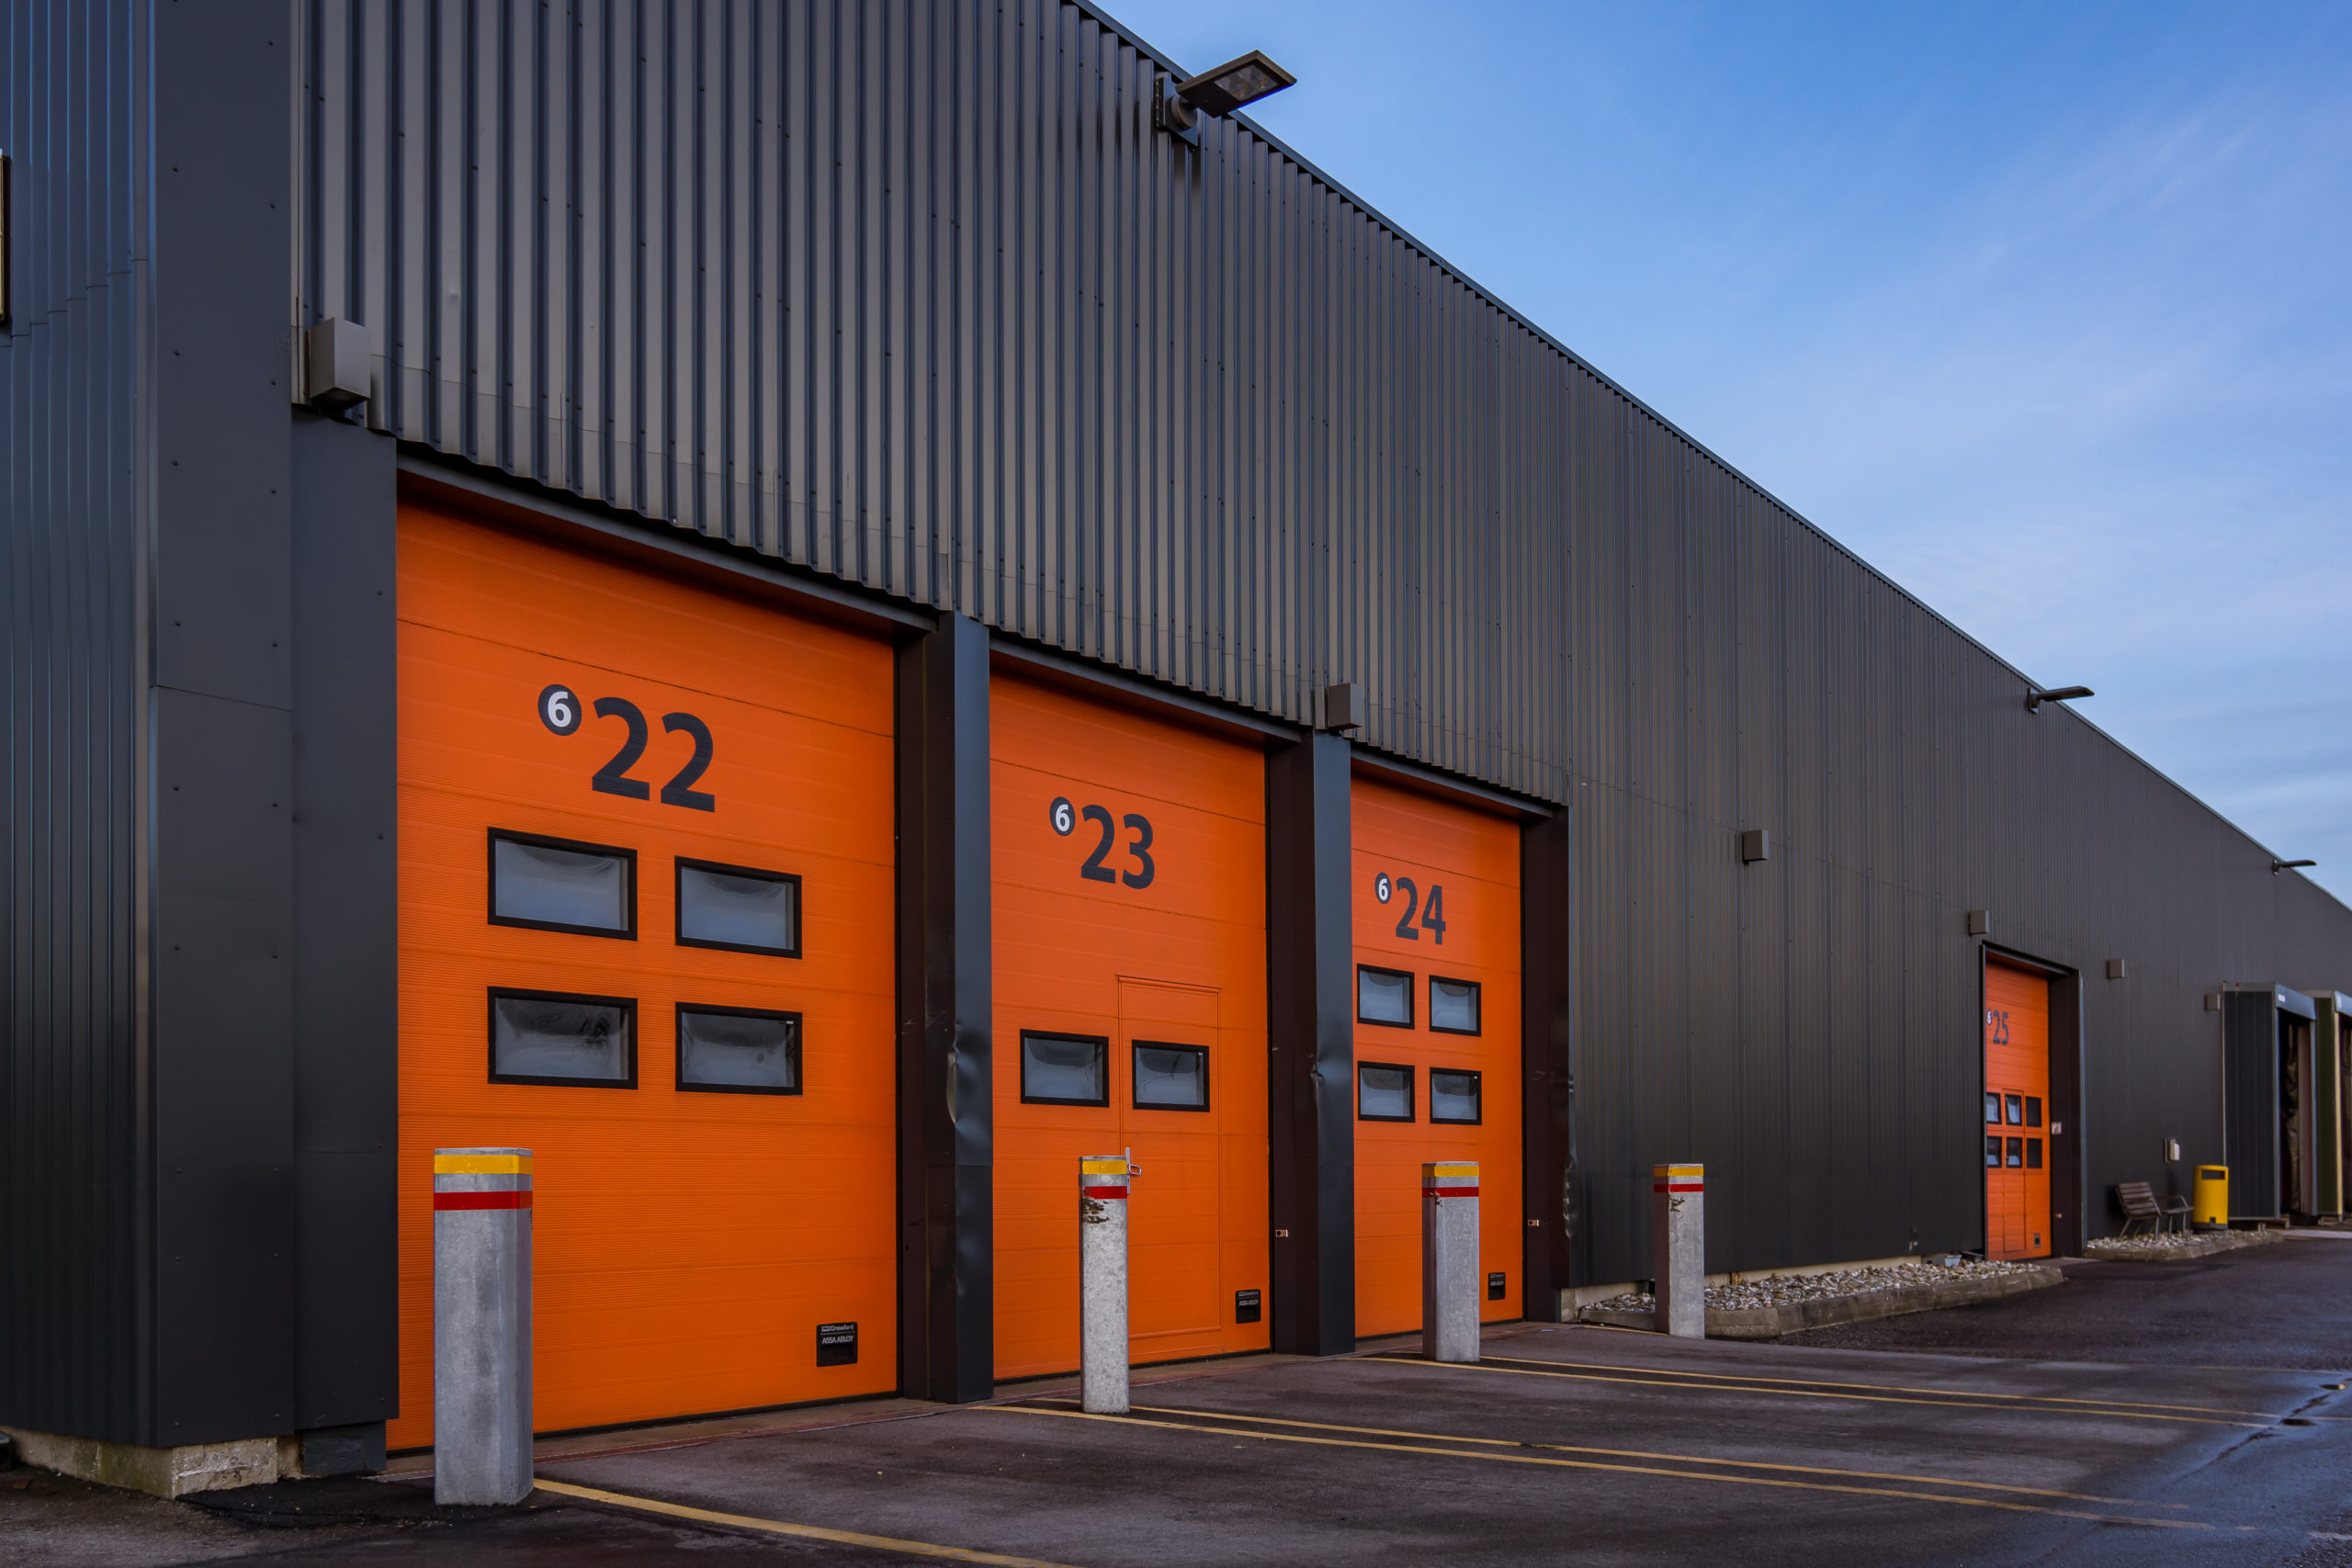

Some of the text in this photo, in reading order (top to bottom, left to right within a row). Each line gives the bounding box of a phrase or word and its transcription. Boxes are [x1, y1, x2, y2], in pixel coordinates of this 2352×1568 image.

[548, 691, 716, 814] 6 22
[1055, 804, 1156, 890] 6 23
[1378, 876, 1447, 946] 6 24
[1993, 1009, 2009, 1046] 25
